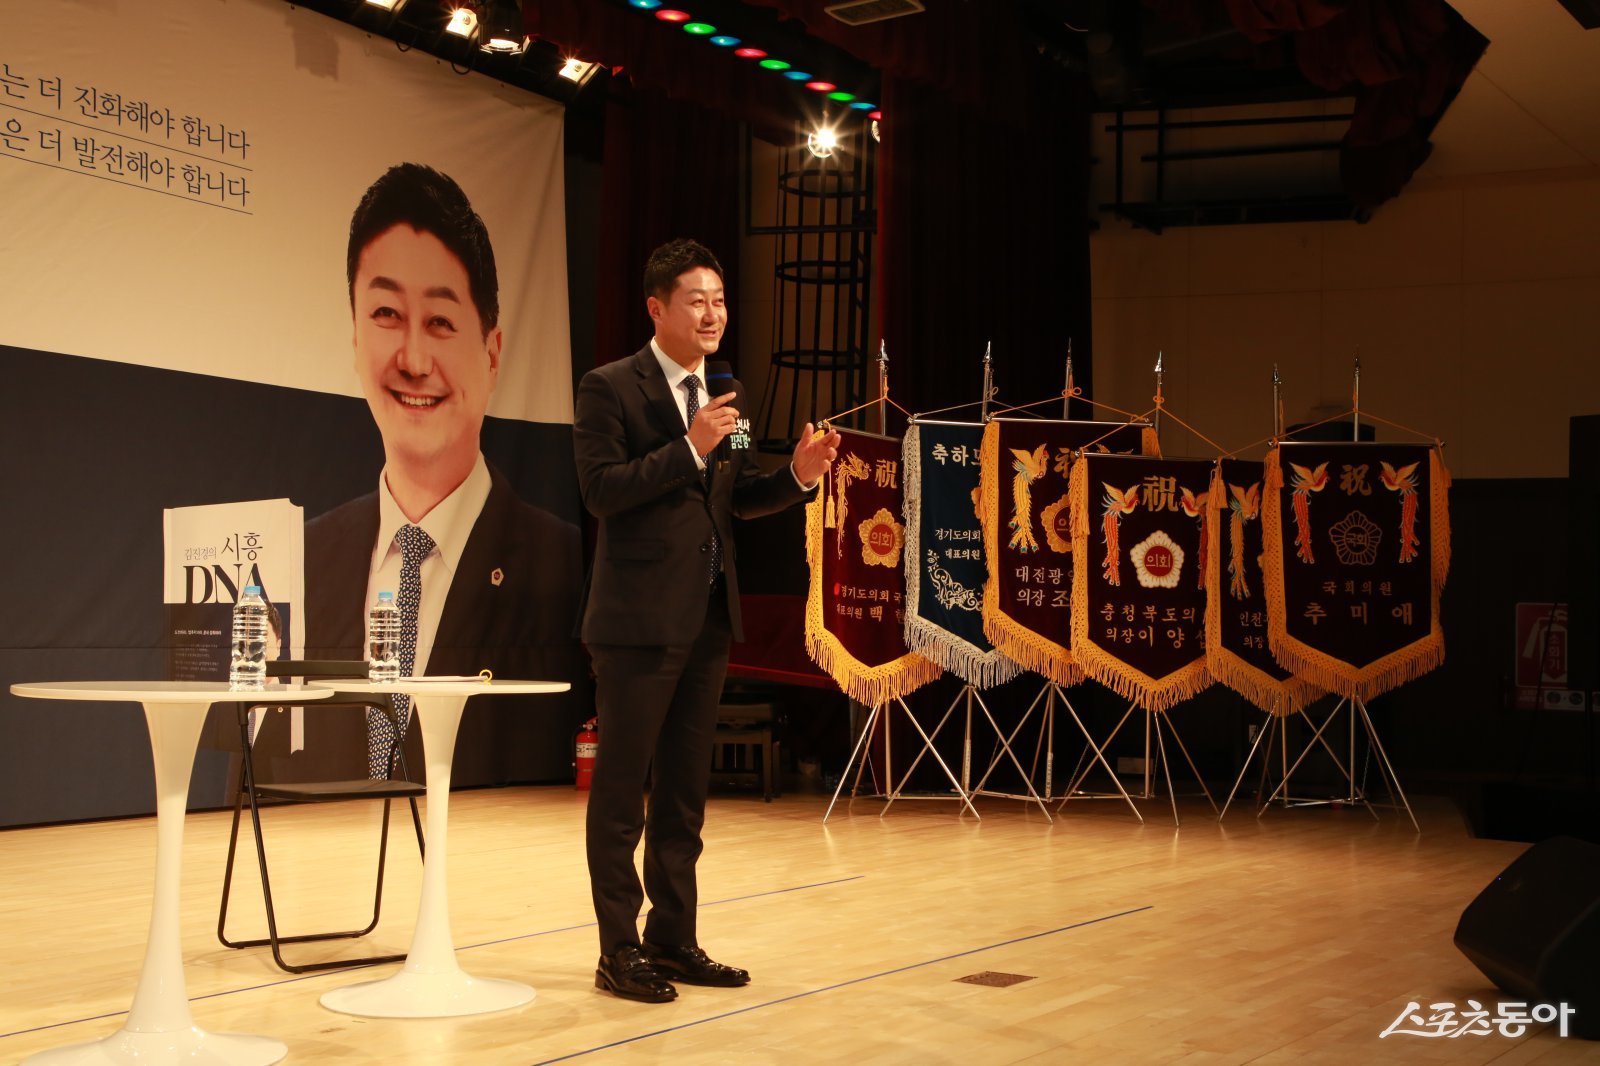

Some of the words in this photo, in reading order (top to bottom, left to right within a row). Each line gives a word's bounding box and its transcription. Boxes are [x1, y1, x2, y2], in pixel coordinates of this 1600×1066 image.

[0, 64, 29, 99] 는
[38, 77, 61, 110] 더
[74, 87, 175, 139] 진화해야
[181, 116, 250, 160] 합니다
[0, 118, 29, 151] 은
[38, 129, 61, 162] 더
[72, 137, 175, 188] 발전해야
[181, 164, 250, 207] 합니다
[875, 459, 897, 489] 祝
[1340, 464, 1372, 496] 祝
[1142, 475, 1179, 512] 祝
[870, 532, 893, 547] 의회
[934, 528, 981, 542] 경기도의회
[184, 546, 217, 561] 김진경의
[221, 532, 264, 561] 시흥
[944, 548, 981, 560] 대표의원
[1145, 554, 1171, 569] 의회
[183, 563, 270, 604] DNA
[841, 585, 889, 602] 경기도의회
[1017, 588, 1045, 607] 의장
[1240, 611, 1268, 627] 인천
[1105, 627, 1135, 644] 의장
[1242, 635, 1263, 648] 의장
